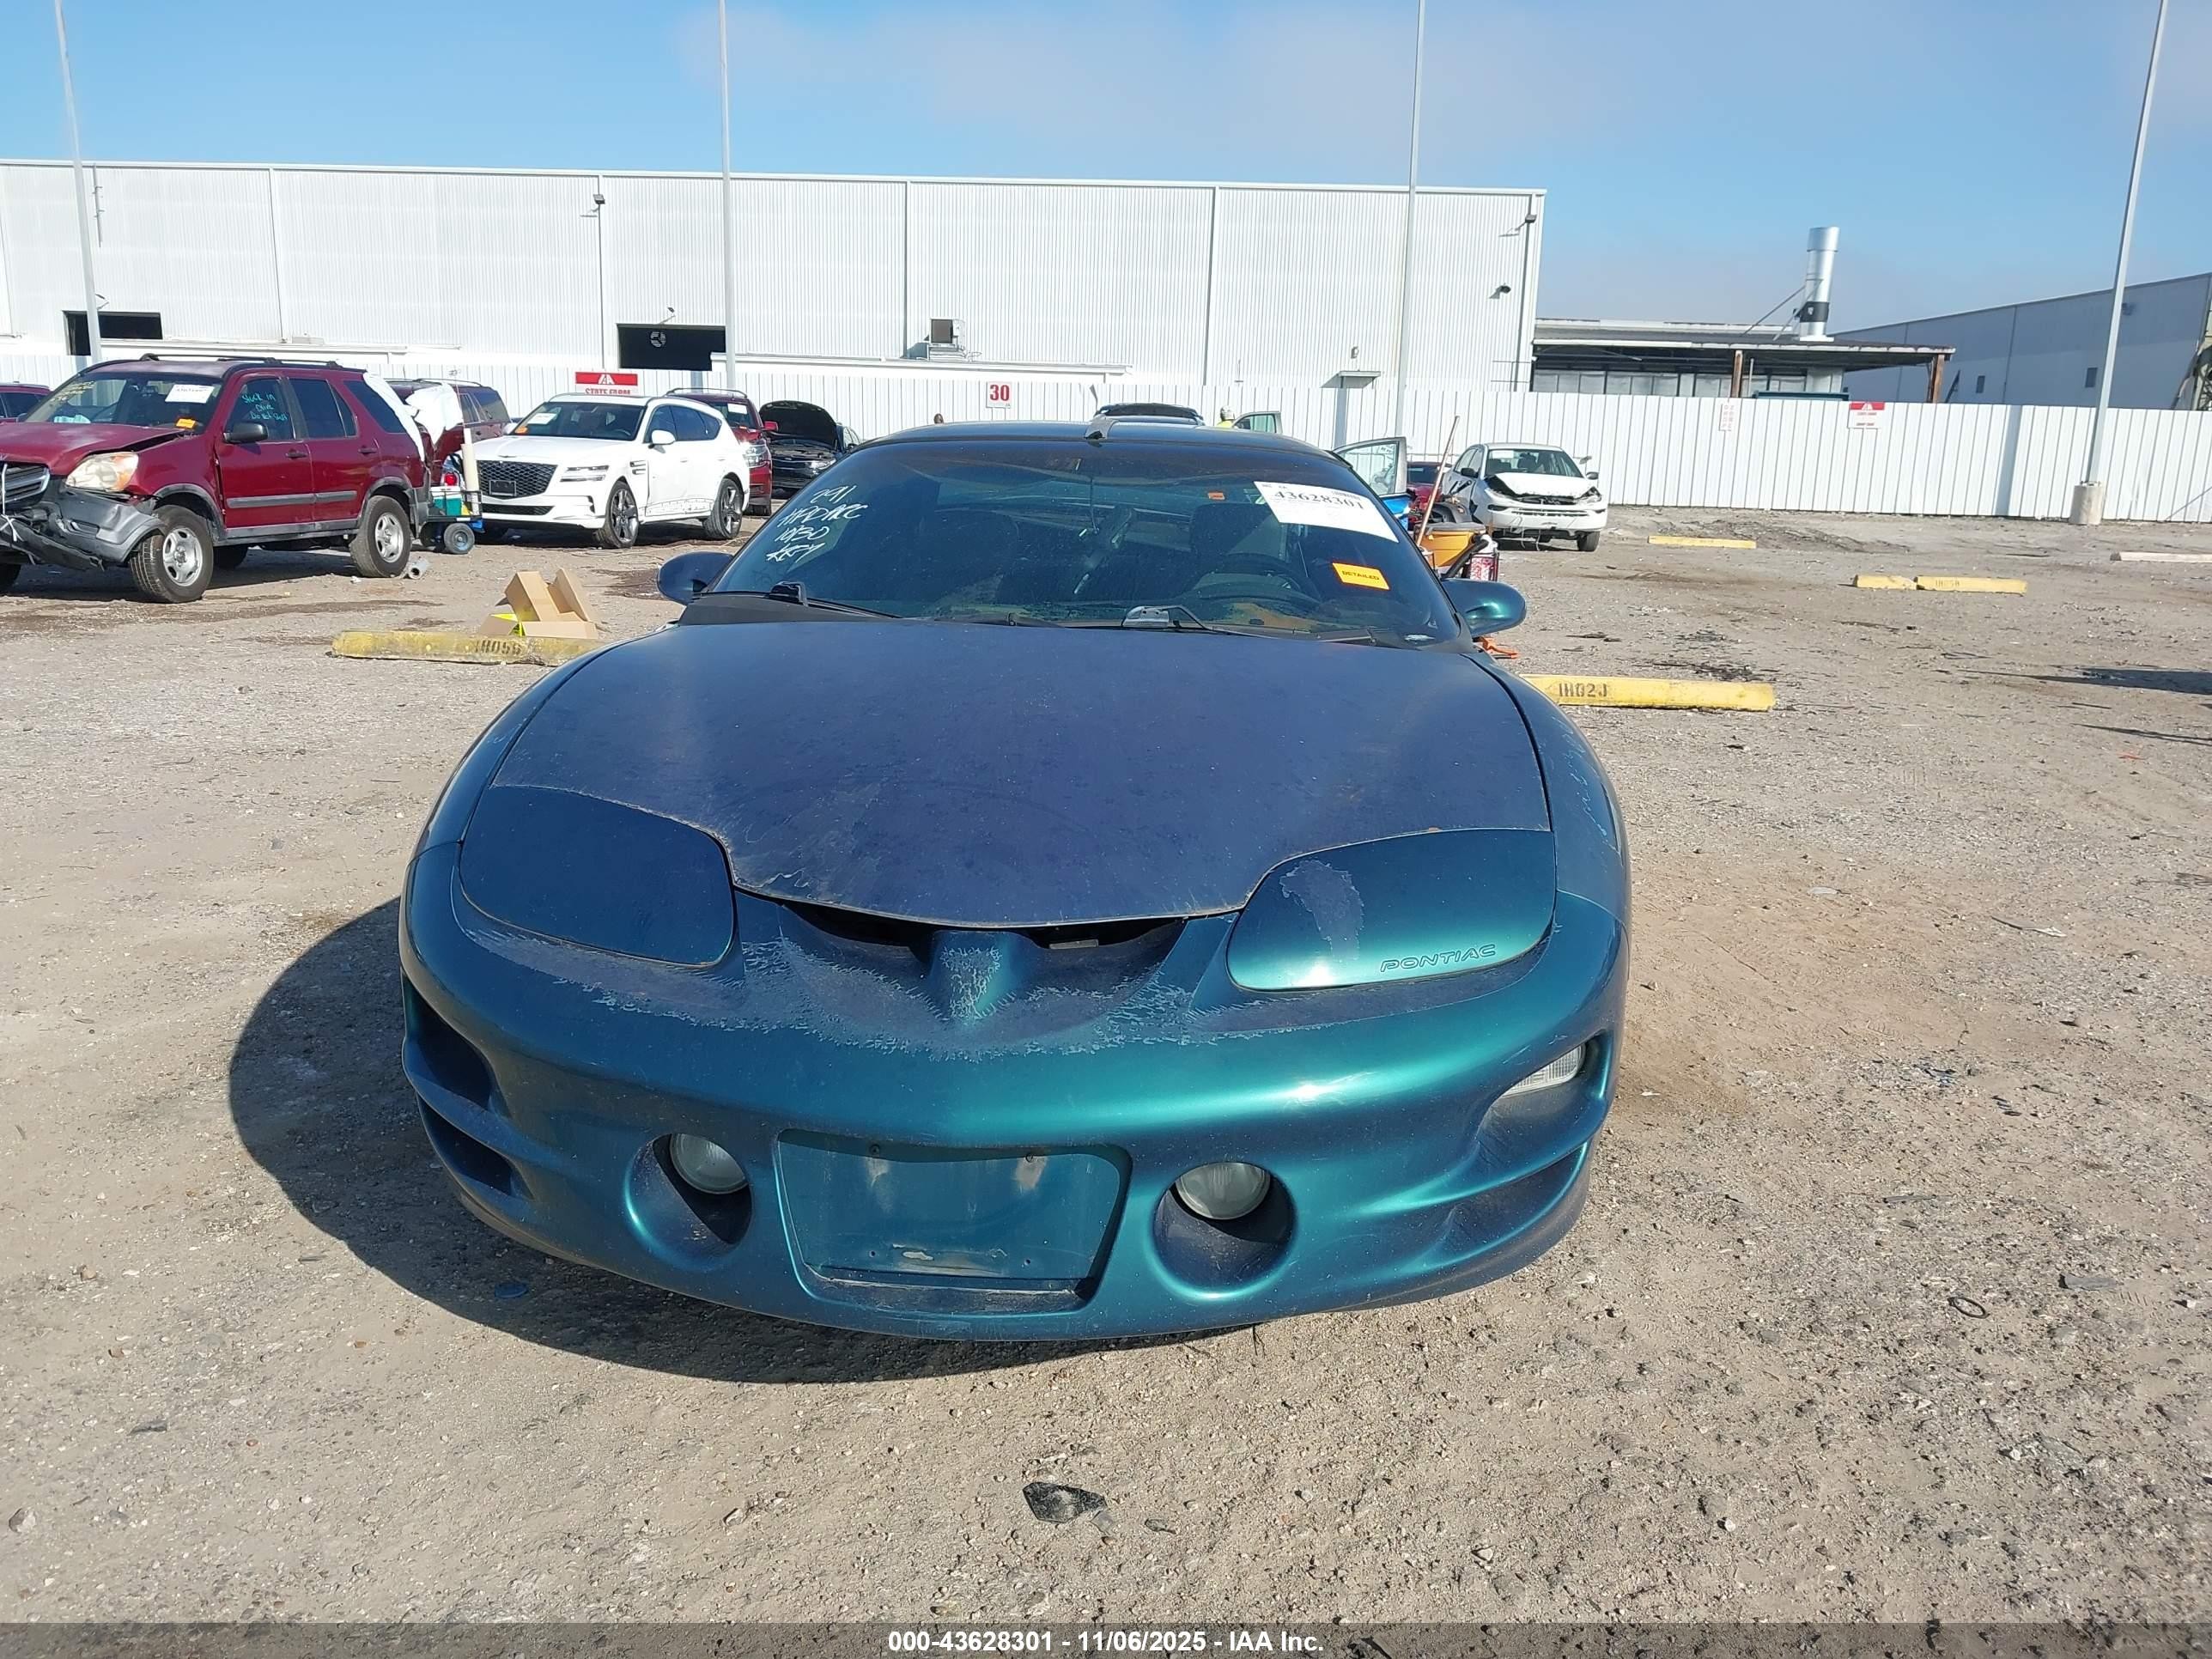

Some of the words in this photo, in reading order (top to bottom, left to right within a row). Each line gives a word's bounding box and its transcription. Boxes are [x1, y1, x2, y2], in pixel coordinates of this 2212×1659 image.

[989, 384, 1010, 402] 30
[1274, 491, 1365, 510] 43628301
[1341, 570, 1380, 580] DETAILED
[1380, 944, 1497, 972] PONTIAC
